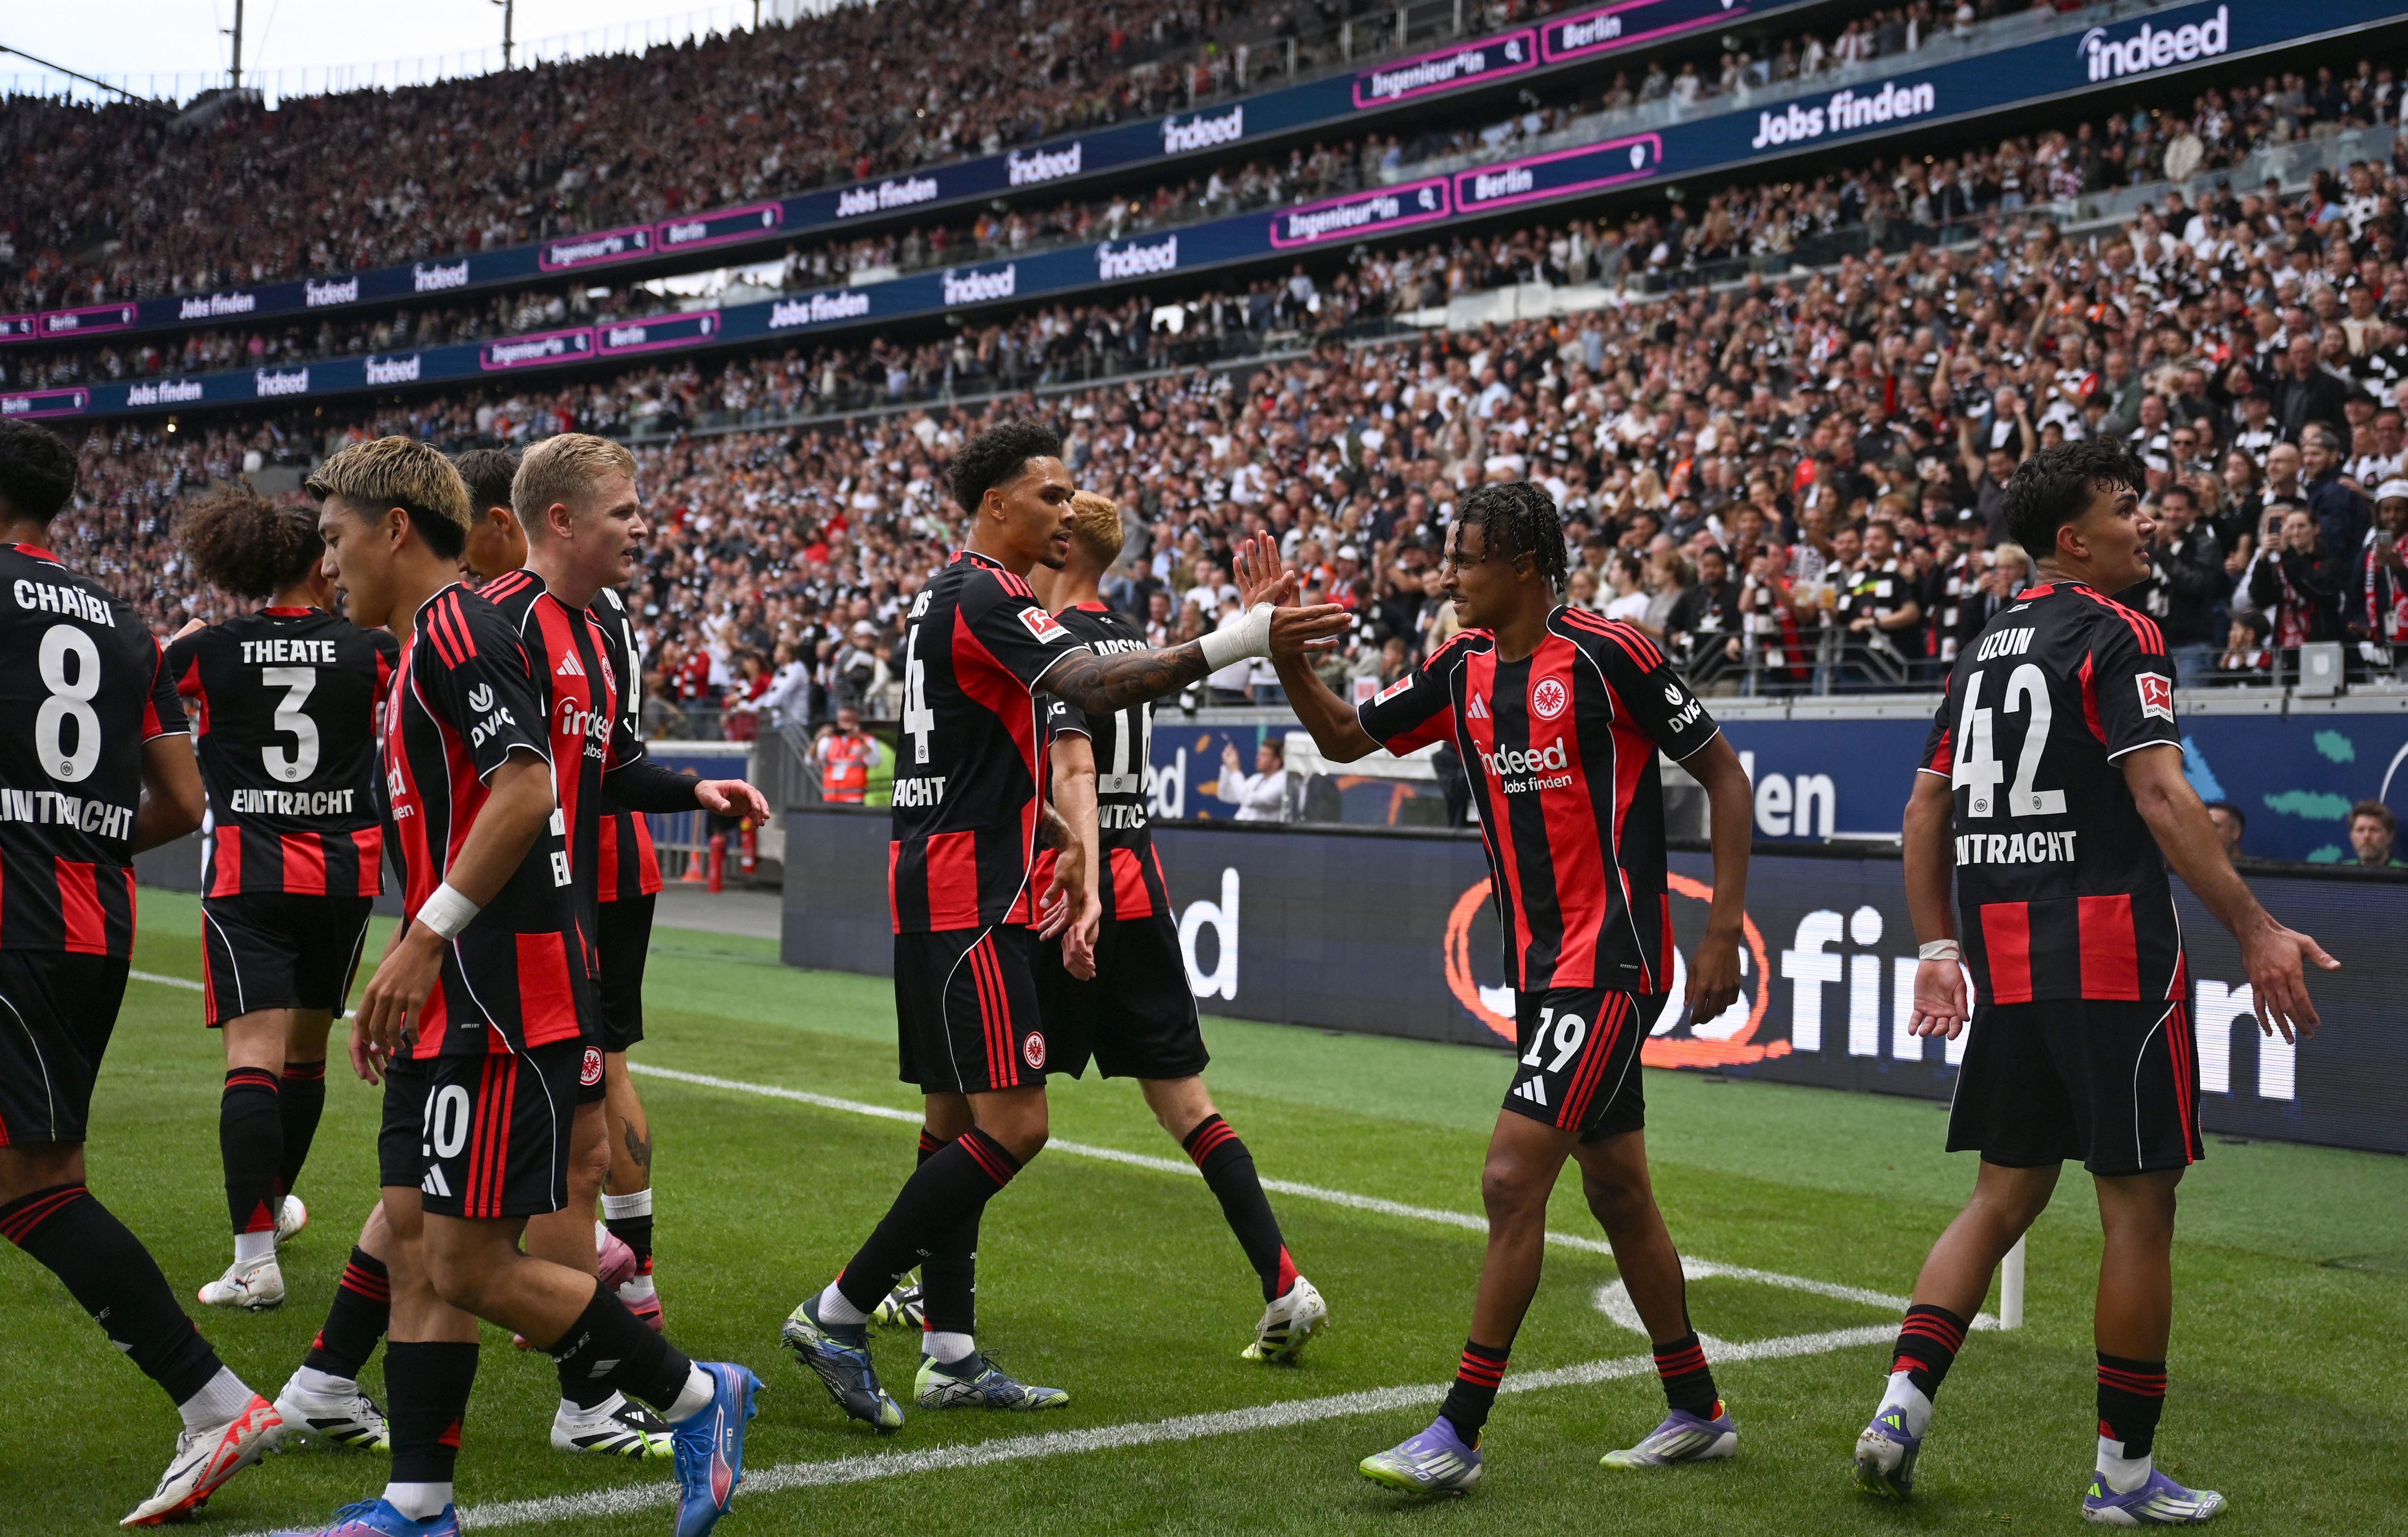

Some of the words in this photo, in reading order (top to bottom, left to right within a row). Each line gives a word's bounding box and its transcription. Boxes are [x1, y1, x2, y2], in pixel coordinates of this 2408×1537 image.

[1563, 15, 1621, 49] Berlin
[2077, 5, 2229, 82] indeed
[1160, 106, 1242, 154] indeed
[1752, 105, 1824, 148] Jobs
[1827, 81, 1934, 131] finden
[1005, 143, 1081, 186] indeed
[836, 189, 877, 218] Jobs
[878, 178, 937, 207] finden
[1475, 167, 1532, 200] Berlin
[669, 223, 706, 243] Berlin
[1095, 234, 1177, 281] indeed
[304, 277, 358, 307] indeed
[413, 259, 468, 292] indeed
[941, 265, 1015, 305] indeed
[179, 298, 210, 320] Jobs
[211, 292, 255, 315] finden
[769, 300, 810, 328] Jobs
[811, 290, 869, 321] finden
[609, 325, 646, 347] Berlin
[254, 367, 308, 396] indeed
[364, 354, 420, 385] indeed
[127, 384, 158, 406] Jobs
[159, 379, 202, 403] finden
[14, 579, 115, 628] CHAÏBI
[241, 639, 336, 663] THEATE
[1977, 627, 2035, 662] UZUN
[35, 624, 100, 782] 8
[1667, 697, 1701, 733] DVAG
[262, 667, 319, 782] 3
[1952, 663, 2067, 818] 42
[583, 743, 602, 759] Jobs
[1474, 737, 1568, 776] indeed
[230, 789, 354, 815] EINTRACHT
[1503, 779, 1526, 794] Jobs
[1528, 775, 1572, 791] finden
[0, 788, 133, 841] INTRACHT
[1521, 1007, 1586, 1073] 19
[2195, 1494, 2223, 1519] F50
